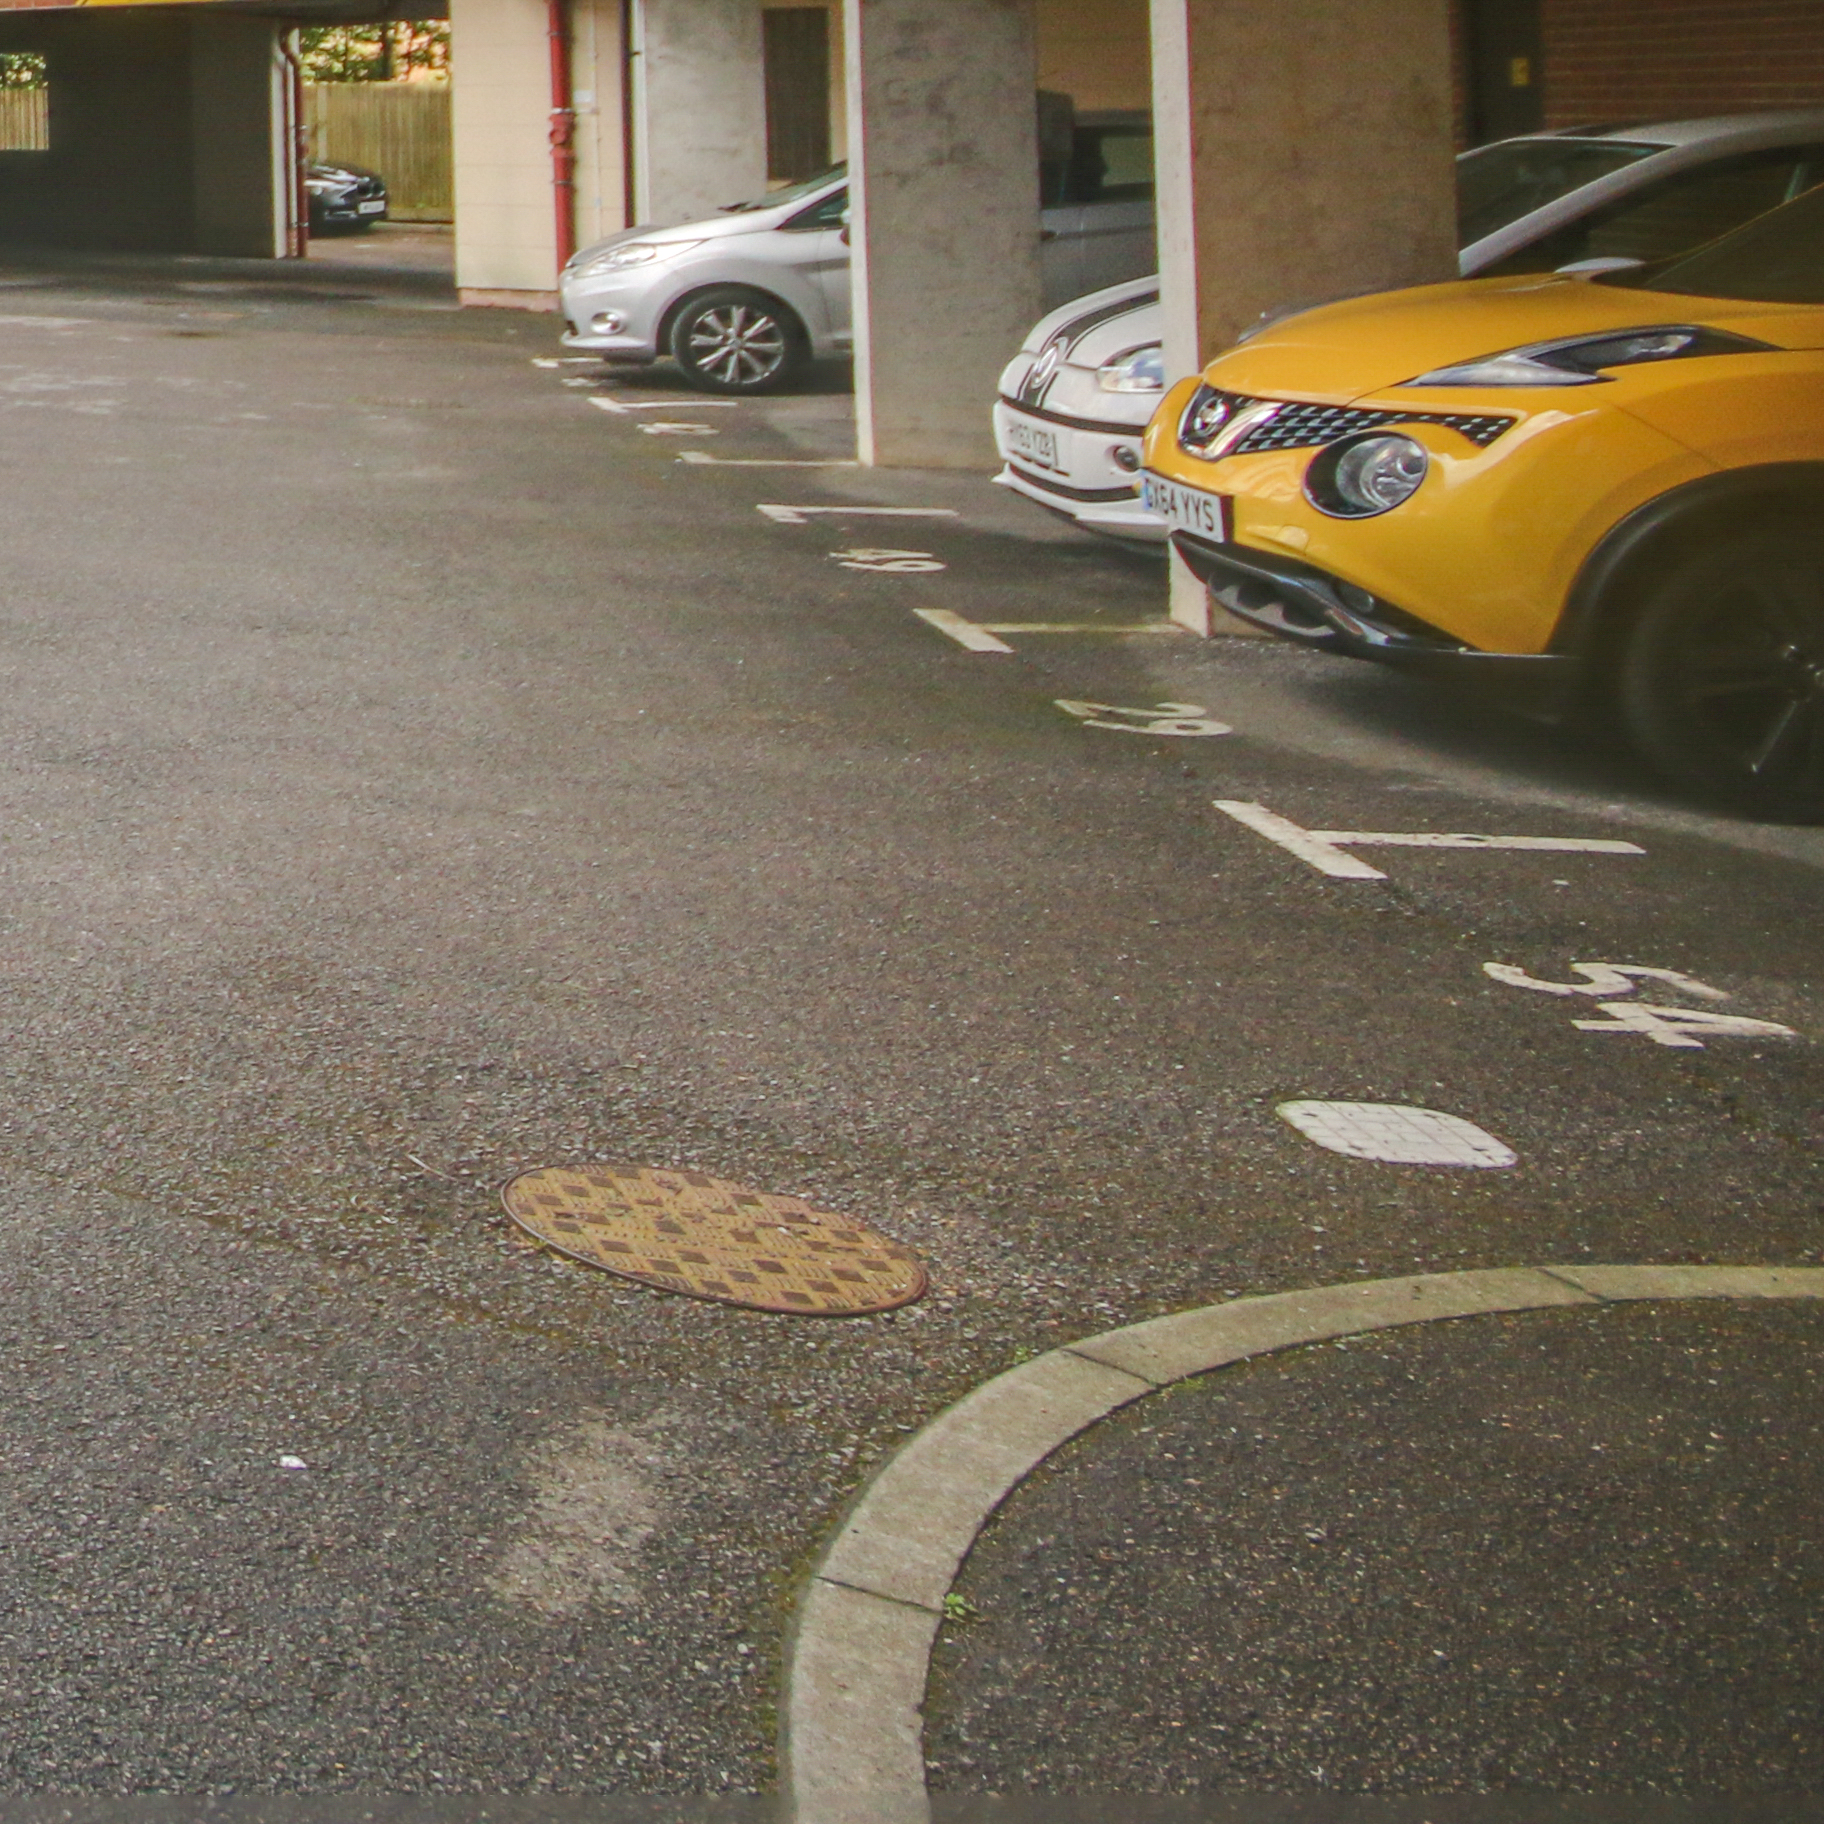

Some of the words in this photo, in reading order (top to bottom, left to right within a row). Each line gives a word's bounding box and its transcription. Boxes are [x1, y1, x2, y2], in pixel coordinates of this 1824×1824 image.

[1143, 477, 1178, 518] GX64
[1180, 490, 1215, 532] YYS
[1482, 961, 1799, 1050] 54
